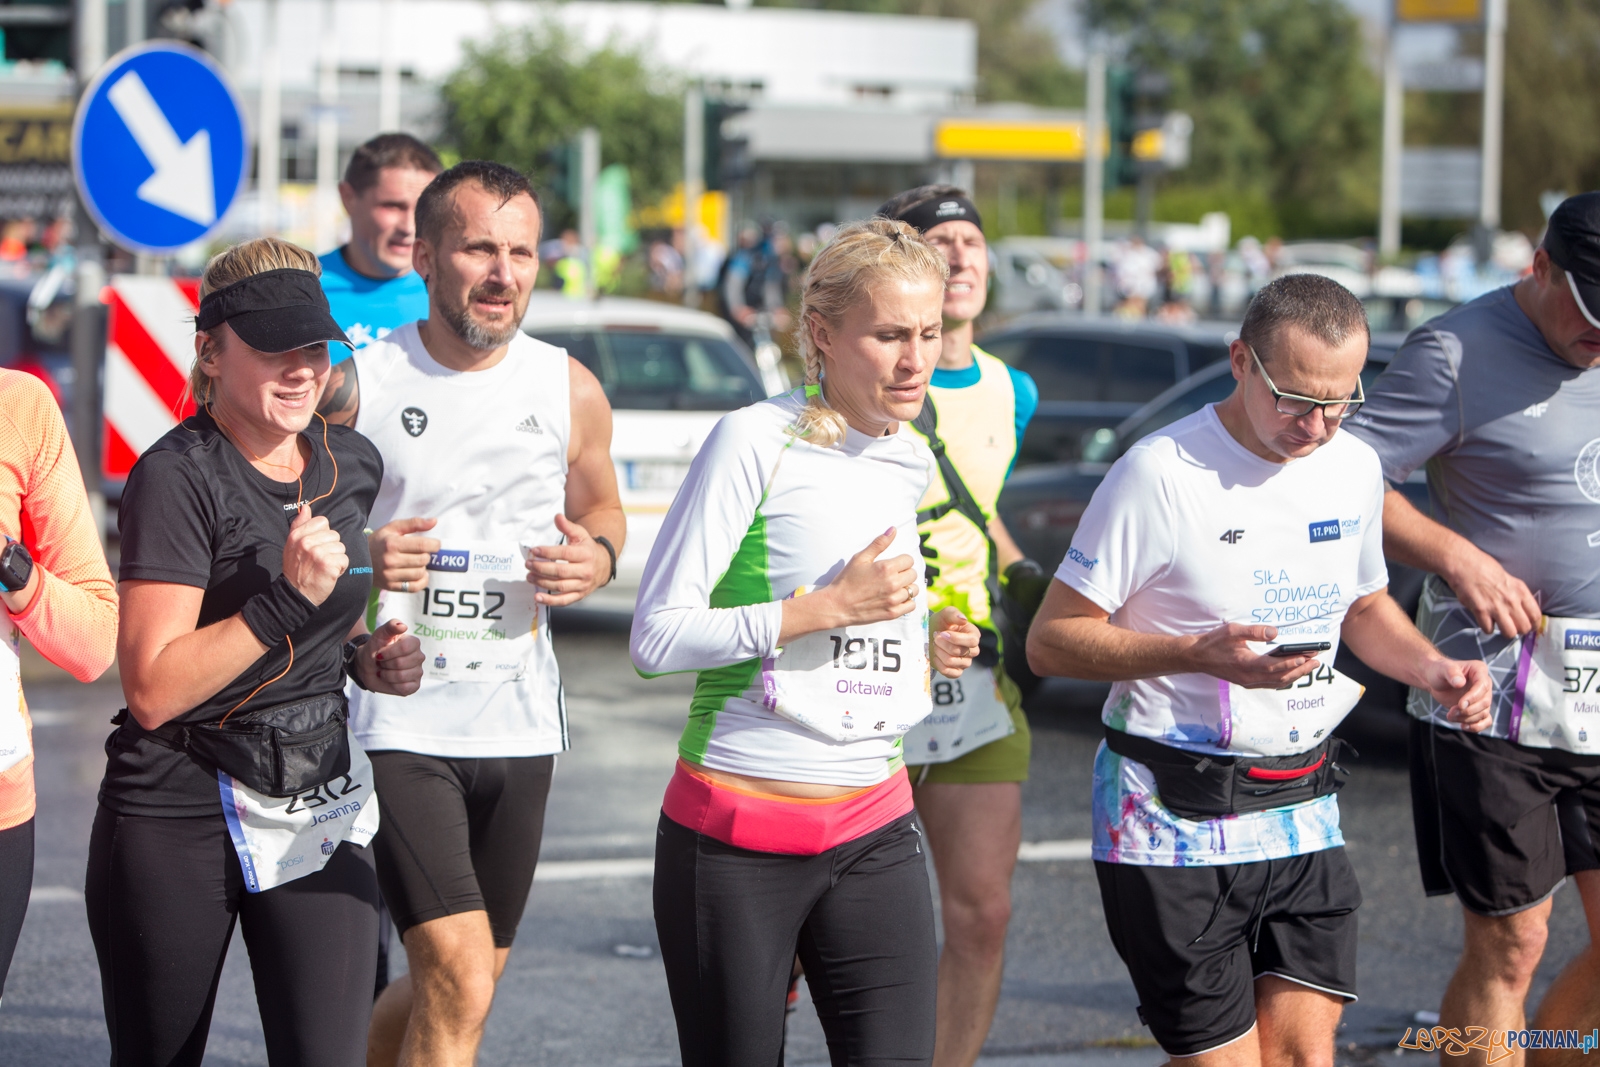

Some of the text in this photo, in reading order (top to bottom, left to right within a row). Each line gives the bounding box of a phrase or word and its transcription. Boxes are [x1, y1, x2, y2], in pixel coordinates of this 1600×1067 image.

[1523, 403, 1549, 418] 4F
[515, 425, 544, 435] adidas
[1219, 529, 1245, 544] 4F
[1253, 569, 1291, 586] SIŁA
[1264, 583, 1341, 604] ODWAGA
[422, 587, 505, 620] 1552
[1250, 599, 1340, 624] SZYBKOŚĆ
[413, 622, 506, 641] Zbigniew Zibi
[830, 635, 902, 673] 1815
[836, 679, 893, 697] Oktawia
[1287, 695, 1325, 712] Robert
[873, 721, 886, 731] 4F
[311, 800, 361, 828] Joanna
